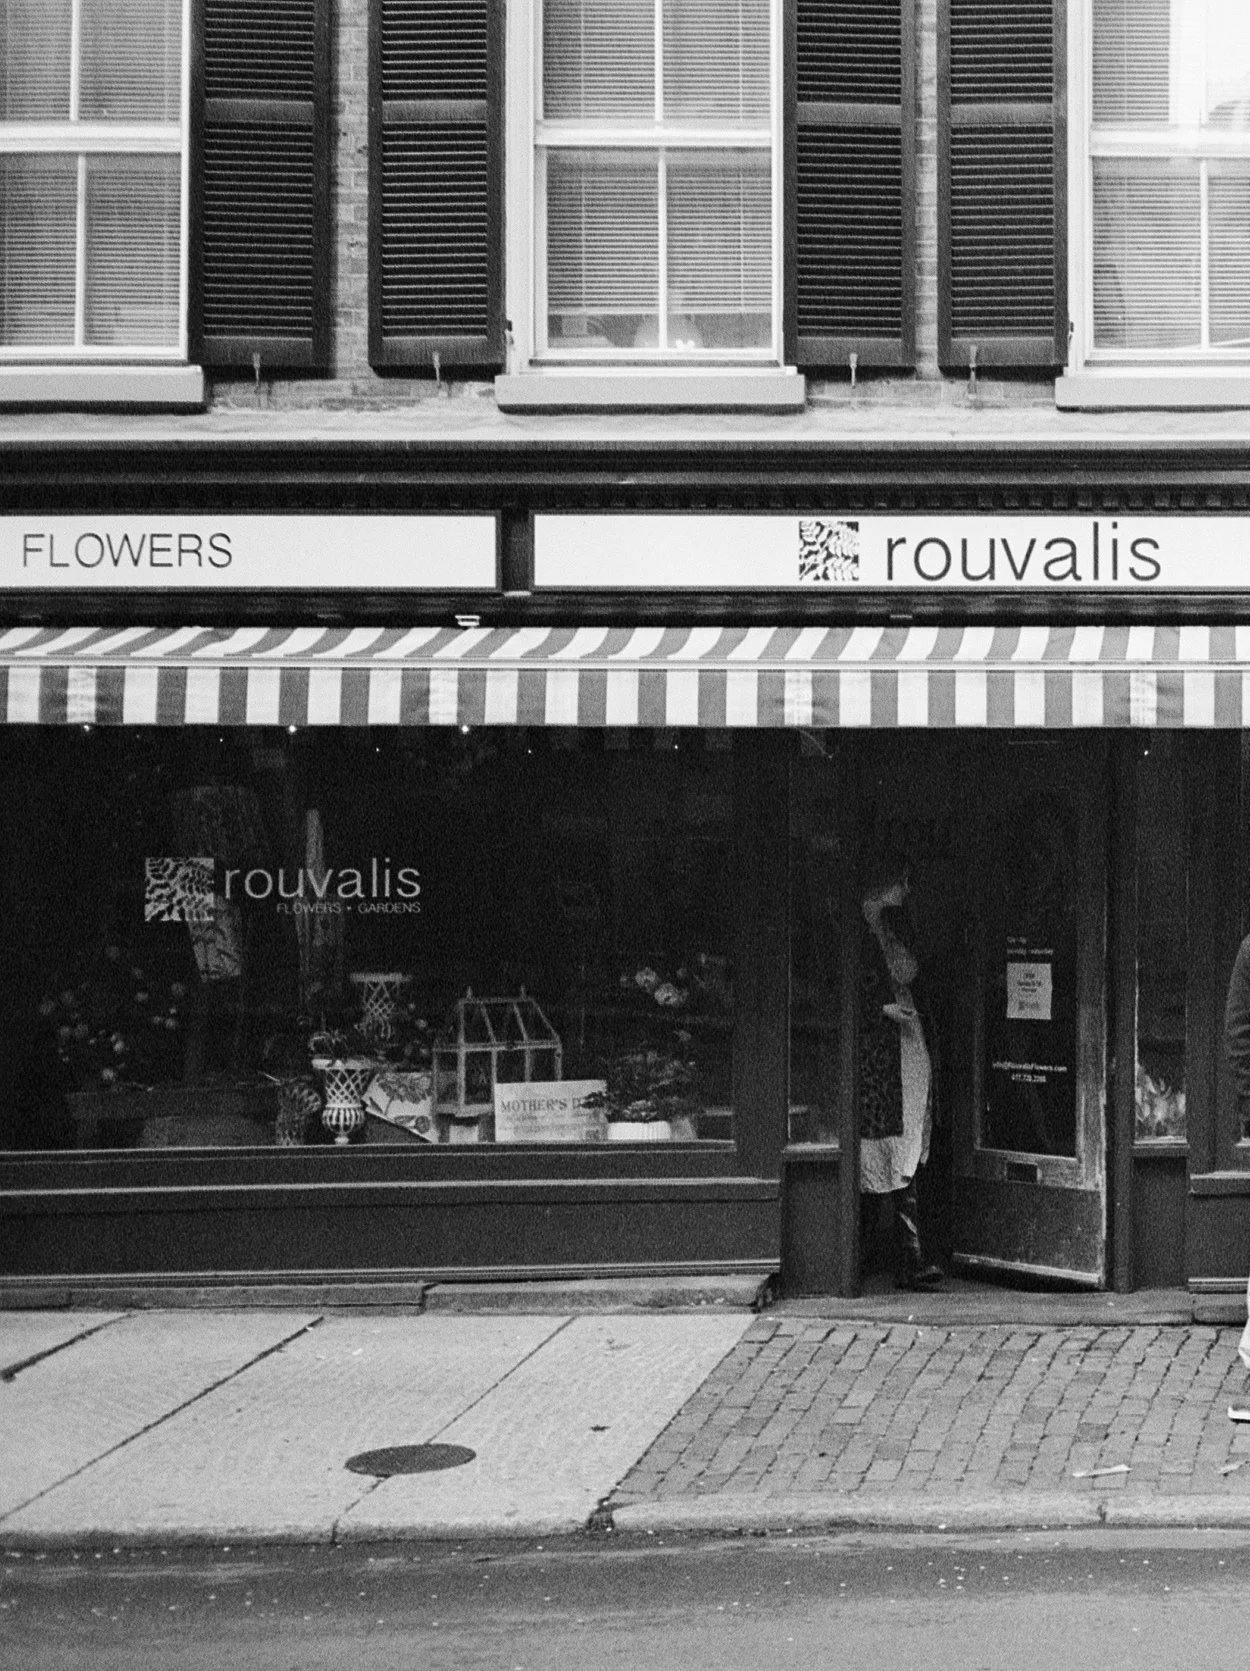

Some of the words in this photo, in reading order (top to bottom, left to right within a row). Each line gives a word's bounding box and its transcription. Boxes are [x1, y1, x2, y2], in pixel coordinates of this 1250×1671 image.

[23, 532, 233, 569] FLOWERS
[886, 521, 1161, 582] rouvalis
[225, 857, 421, 899] rouvalis
[276, 902, 342, 914] FLOWERS
[357, 901, 421, 914] GARDENS
[501, 1098, 568, 1113] MOTHER'S
